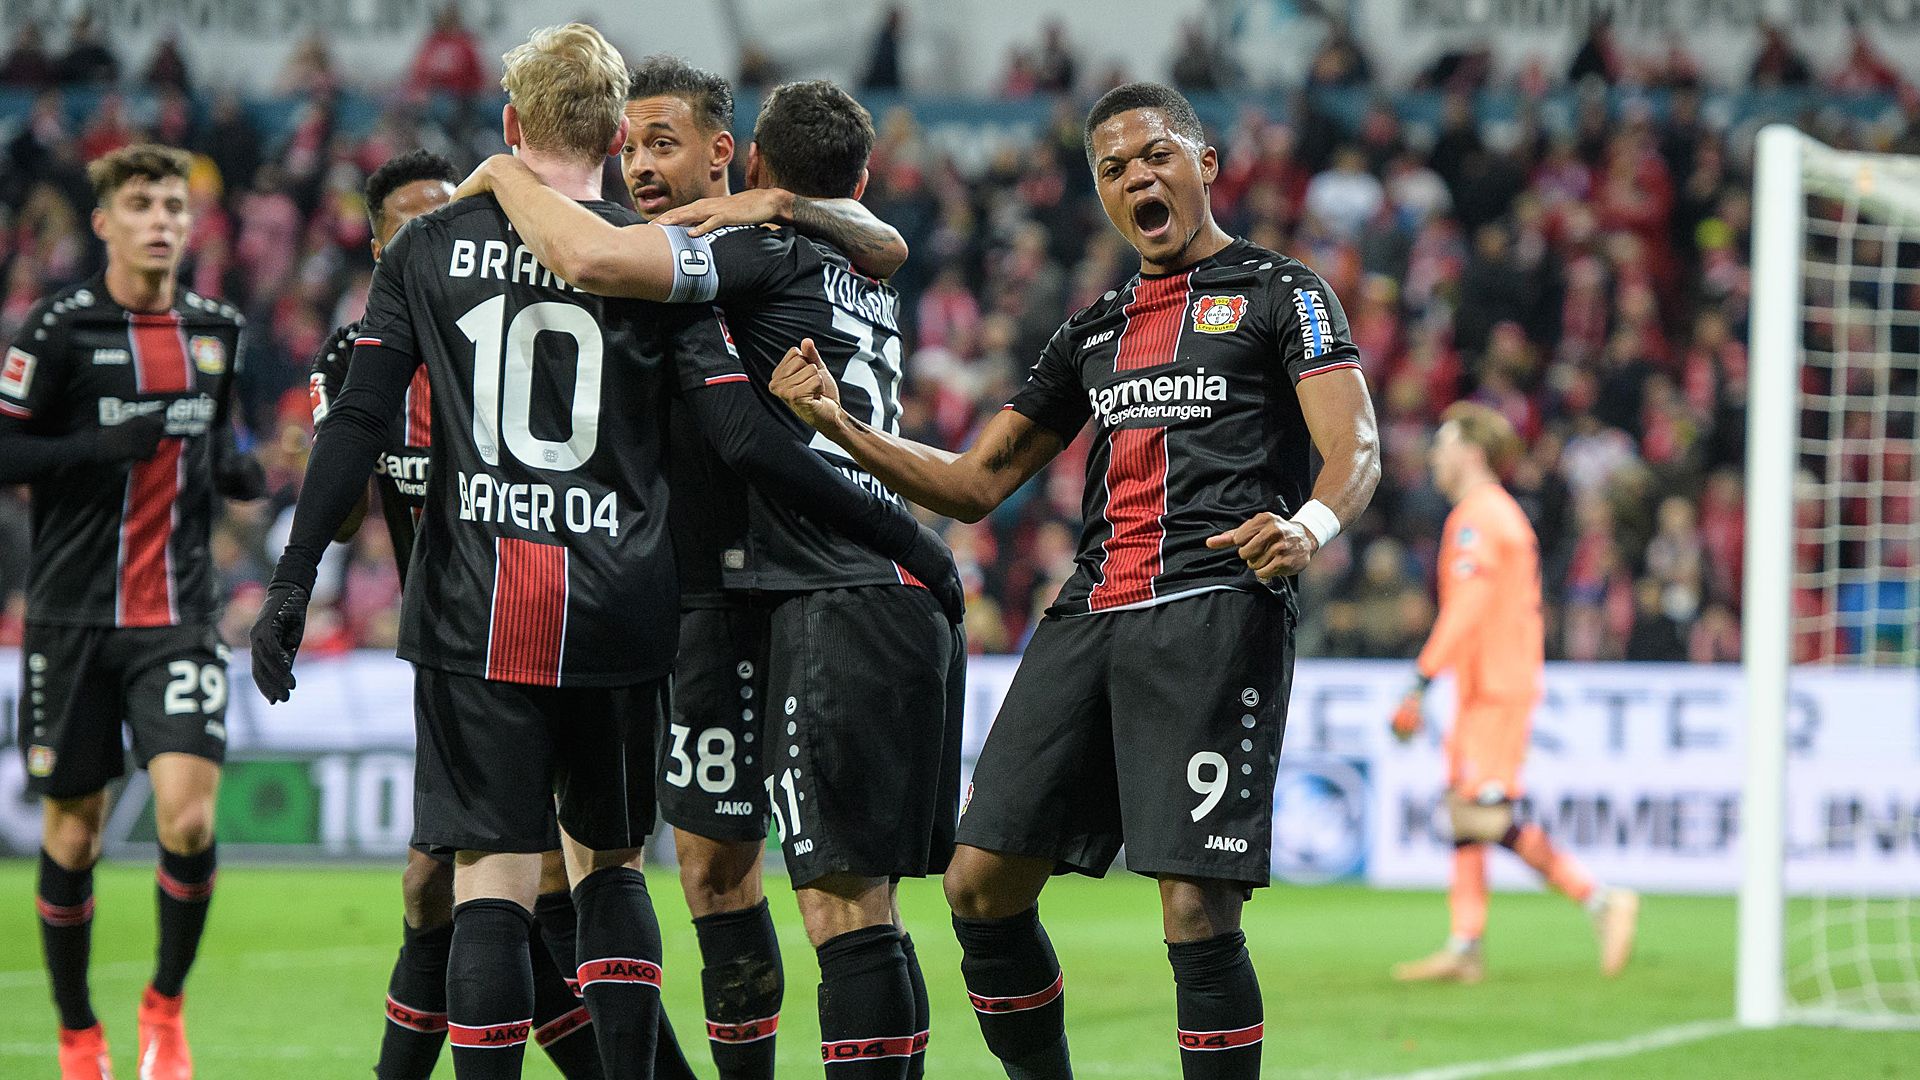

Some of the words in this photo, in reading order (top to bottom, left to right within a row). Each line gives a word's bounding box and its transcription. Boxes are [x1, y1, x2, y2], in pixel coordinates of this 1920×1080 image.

[449, 239, 589, 292] BRAN
[680, 248, 710, 276] C
[1082, 330, 1115, 350] JAKO
[1292, 293, 1316, 360] TRAINING
[454, 293, 604, 472] 10
[1088, 366, 1228, 421] Barmenia
[1103, 403, 1213, 428] Versicherungen
[394, 478, 429, 497] Versi
[458, 471, 556, 533] BAYER
[567, 486, 620, 538] 04
[164, 659, 228, 716] 29
[666, 723, 736, 794] 38
[714, 800, 753, 816] JAKO
[764, 767, 801, 844] 31
[1186, 751, 1229, 823] 9
[1204, 834, 1249, 853] JAKO
[600, 961, 656, 980] JAKO
[479, 1024, 529, 1042] JAKO
